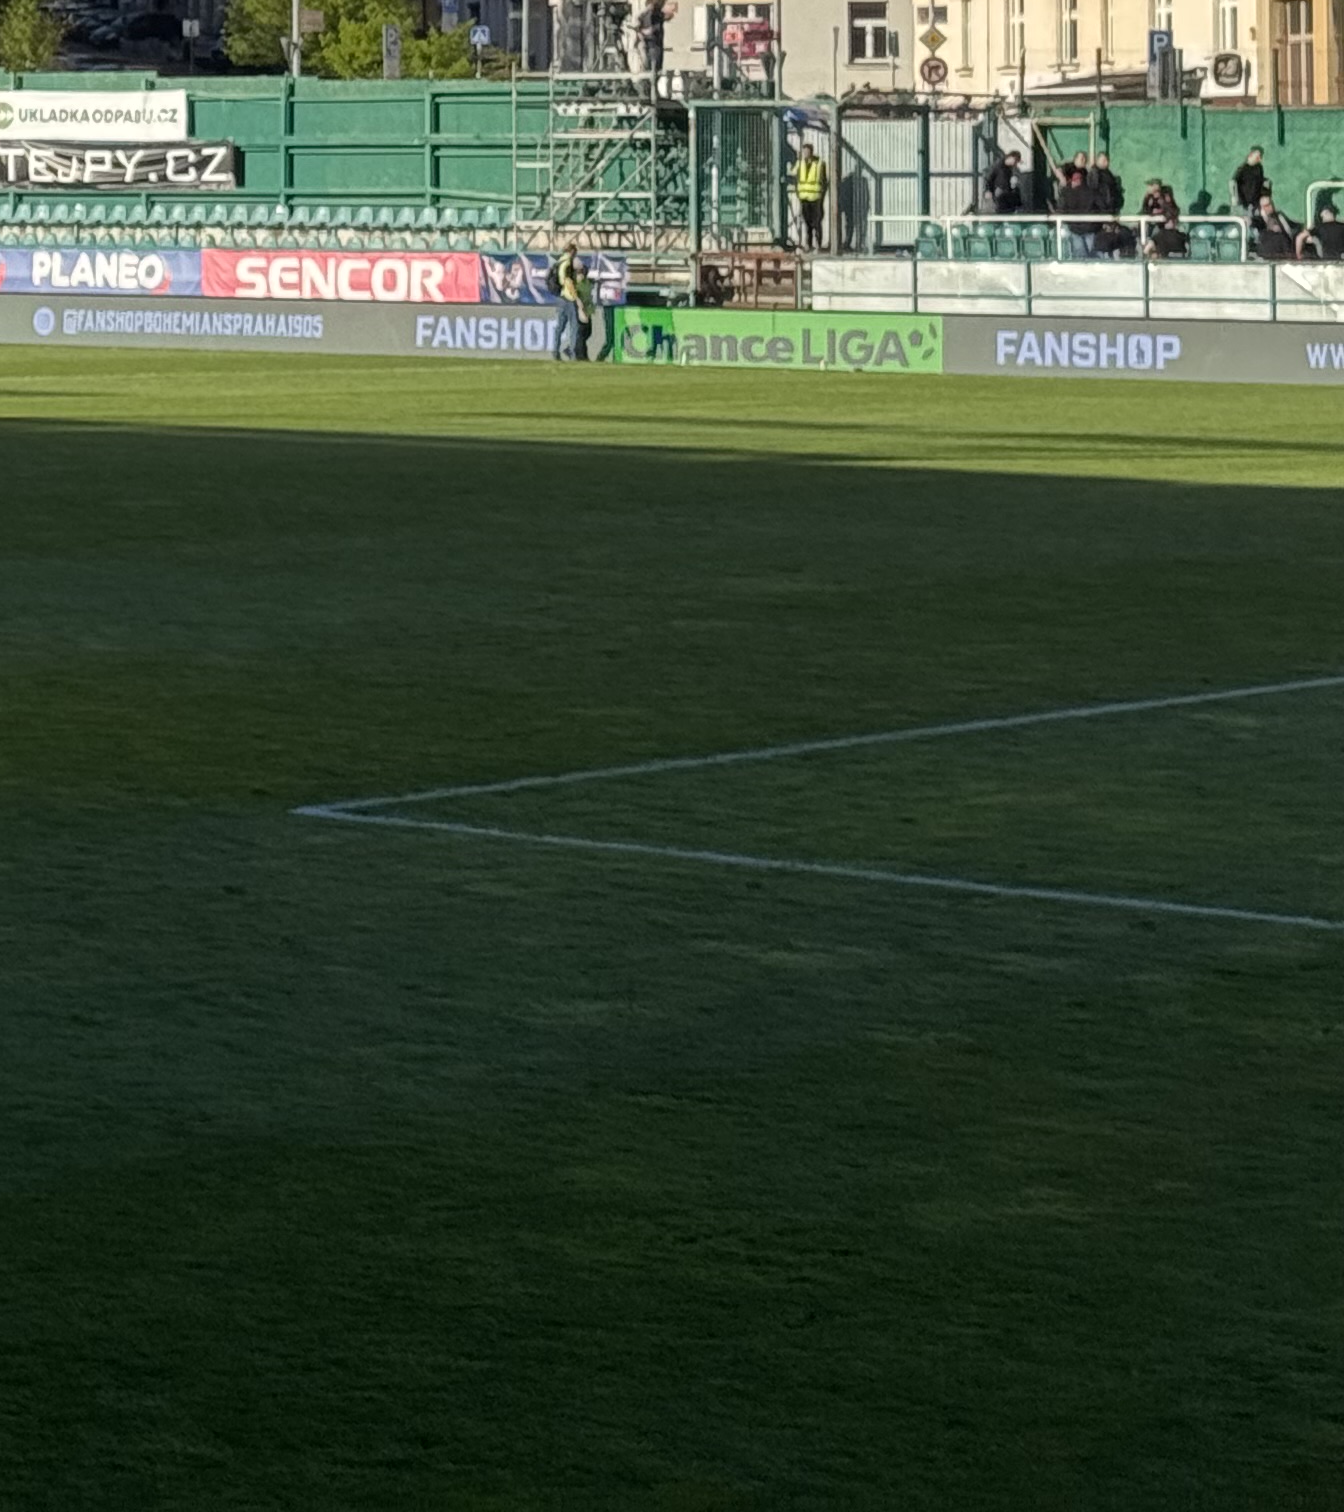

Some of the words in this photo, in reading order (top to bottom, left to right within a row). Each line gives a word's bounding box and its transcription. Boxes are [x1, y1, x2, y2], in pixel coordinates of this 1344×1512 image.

[32, 252, 165, 288] PLANEO
[233, 256, 446, 302] SENCOR
[995, 330, 1182, 370] FANSHOP
